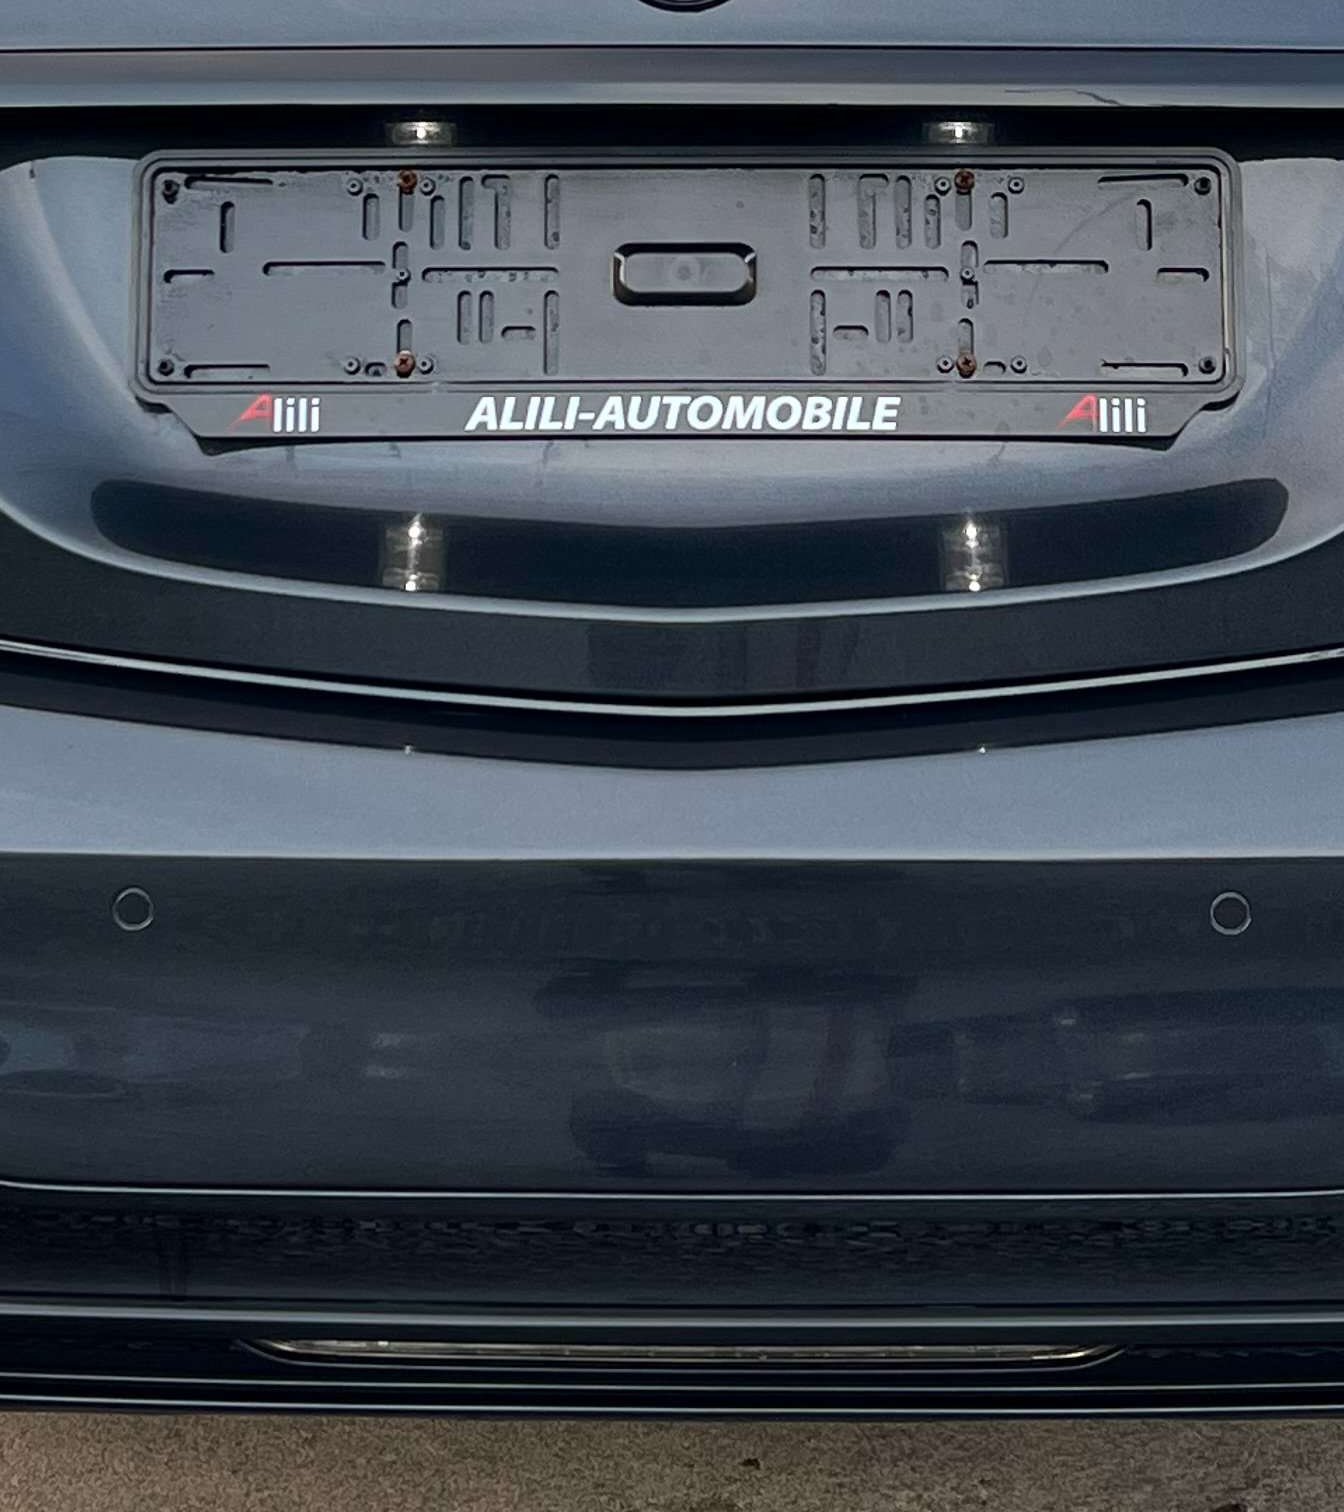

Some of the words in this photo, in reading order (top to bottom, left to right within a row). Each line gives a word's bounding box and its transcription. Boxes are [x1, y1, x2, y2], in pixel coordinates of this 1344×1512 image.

[226, 392, 320, 433] Alili
[464, 395, 902, 432] ALILI-AUTOMOBILE
[1056, 392, 1146, 433] Alili
